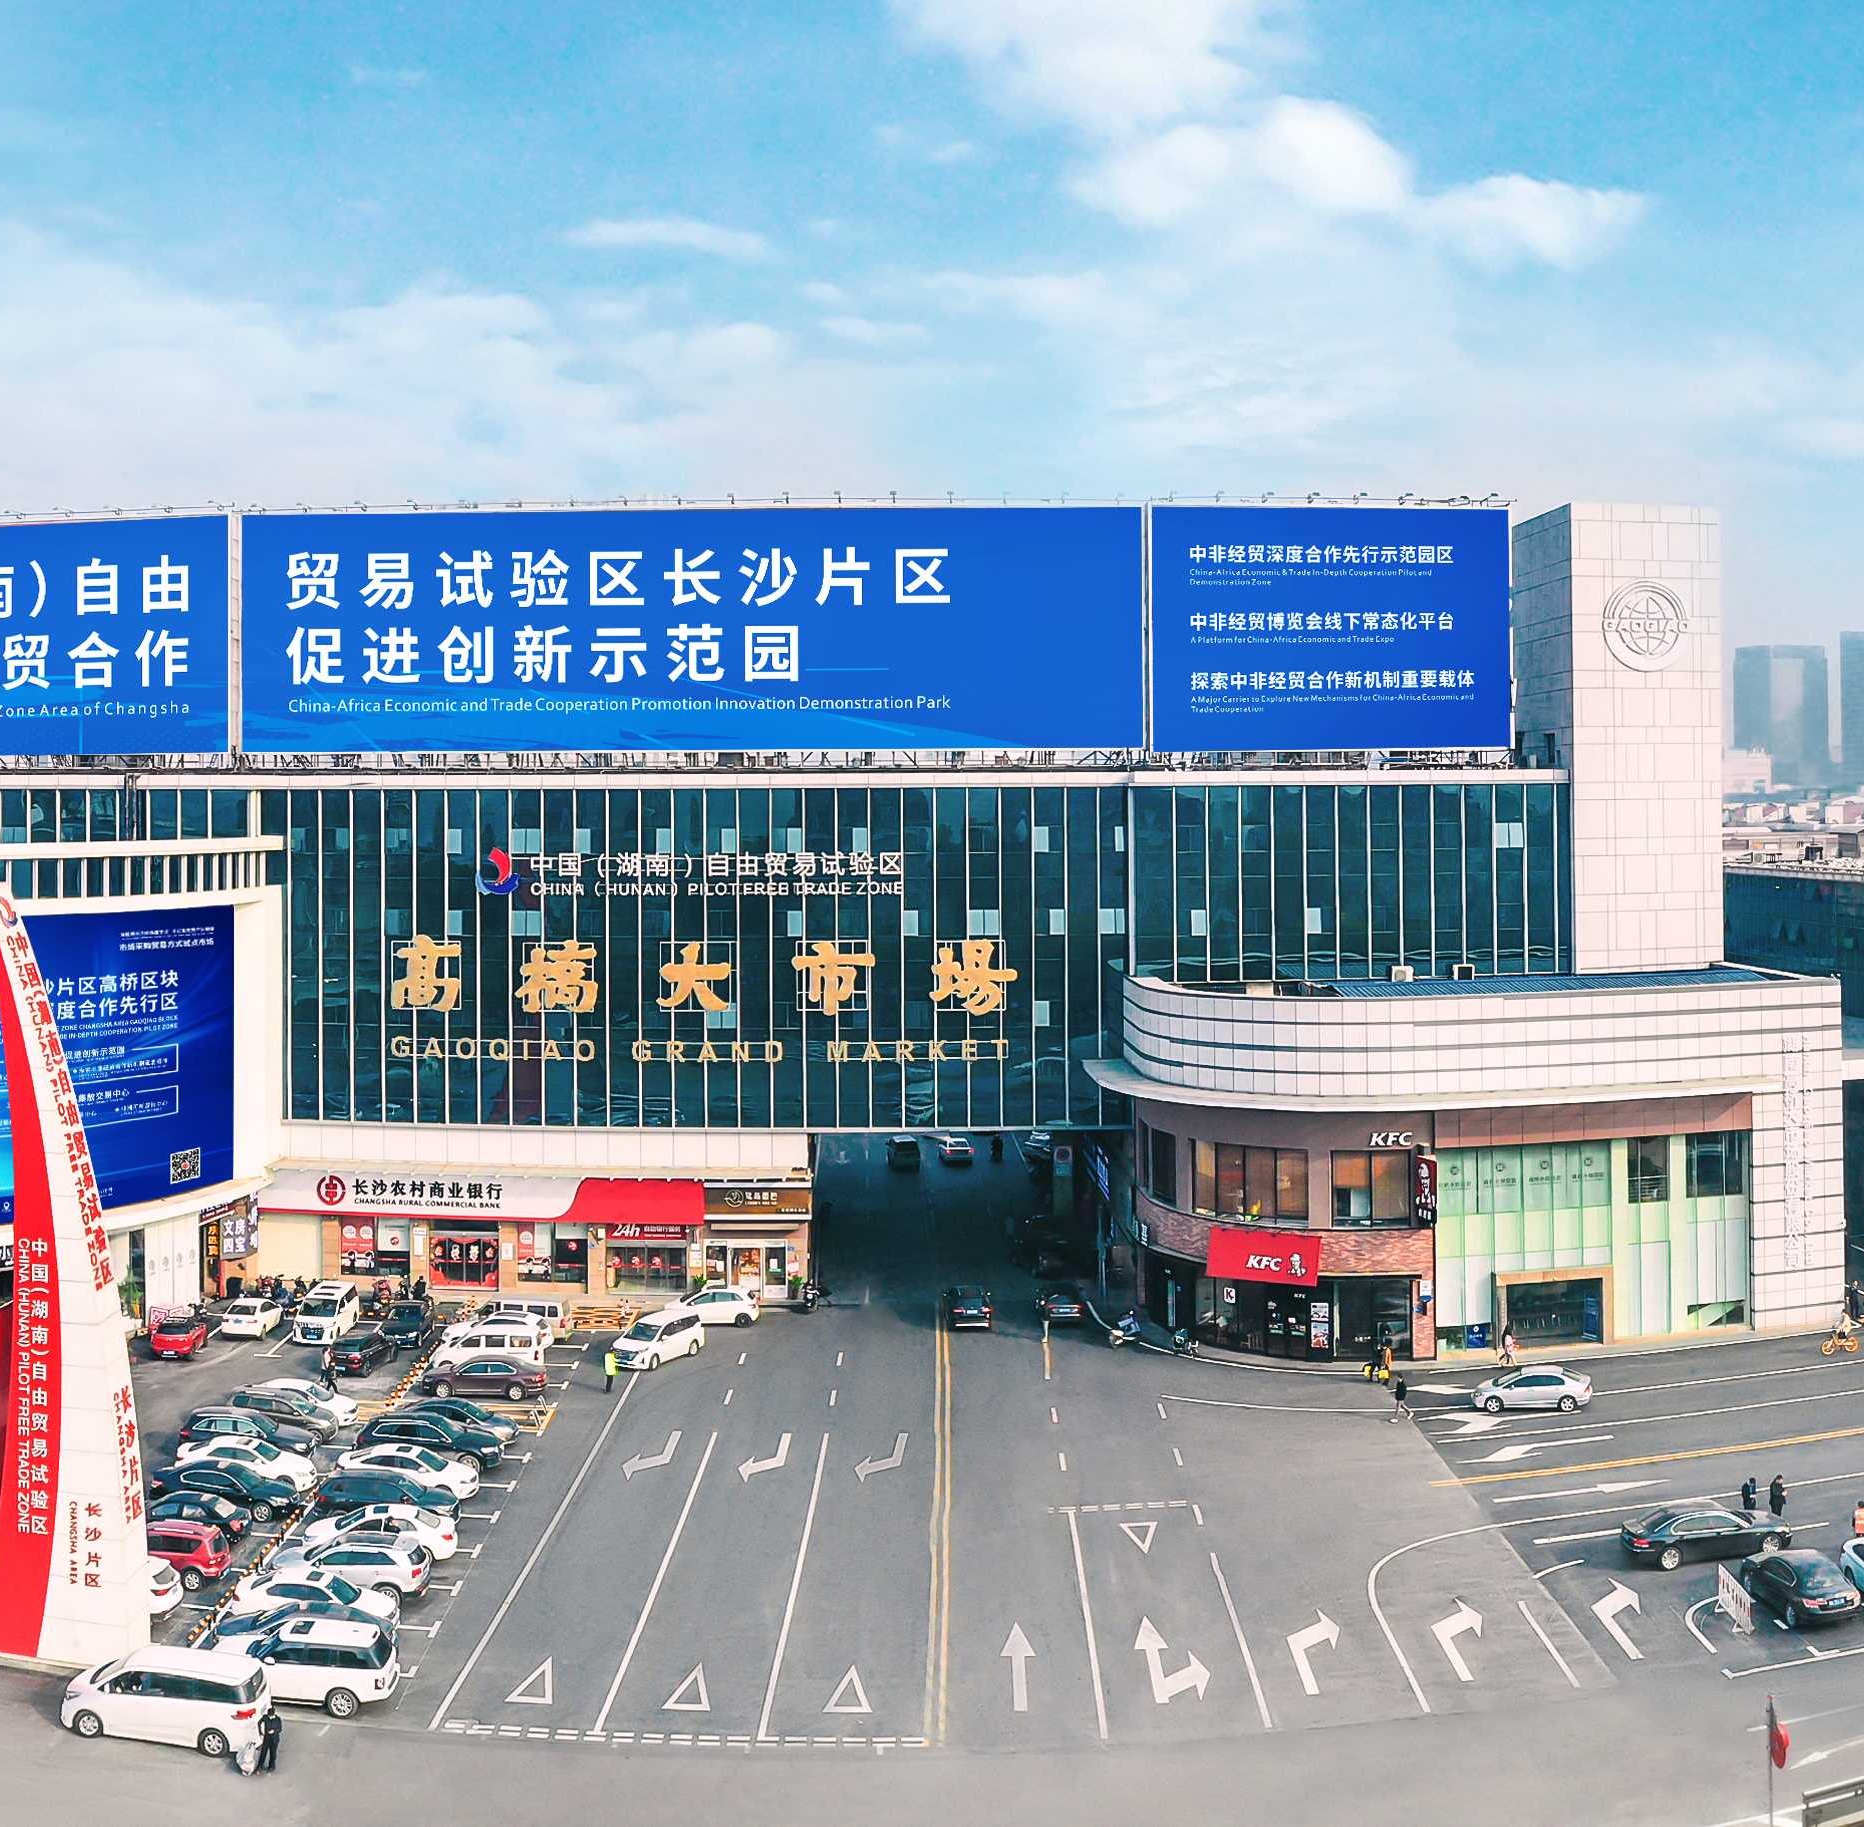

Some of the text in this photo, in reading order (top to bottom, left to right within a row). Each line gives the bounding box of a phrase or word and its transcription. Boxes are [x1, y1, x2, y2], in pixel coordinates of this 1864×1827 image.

[1189, 545, 1454, 564] 中非经贸深度合作先行示范园区
[285, 547, 951, 611] 贸易试验区长沙片区
[1190, 612, 1454, 631] 中非经贸博览会线下常态化平台
[285, 624, 801, 686] 促进创新示范园
[1190, 669, 1475, 690] 探索中非经贸合作新机制重要载体
[39, 703, 79, 717] Area
[83, 702, 101, 717] of
[104, 701, 190, 719] Changsha
[288, 695, 951, 714] China-Africa Economic and Trade Cooperation Promotion Innovation Demonstration Park
[530, 882, 585, 896] CHINA
[688, 882, 735, 896] PILOT
[793, 881, 852, 896] TRADE
[856, 881, 903, 896] ZONE
[390, 1036, 1009, 1063] GAOQIAO GRAND MARKET
[1369, 1131, 1414, 1146] KFC
[352, 1178, 503, 1200] 长沙农村商业银行
[354, 1198, 396, 1206] CHANGSHA
[425, 1199, 478, 1208] COMMERCIAL
[479, 1201, 502, 1209] BANK
[612, 1224, 641, 1238] 24h
[1246, 1254, 1283, 1272] KFC
[17, 1238, 30, 1534] CHINA (HUNAN) PILOT FREE TRADE ZONE
[69, 1501, 78, 1585] CHANGSHA AREA
[84, 1502, 102, 1588] 长沙片区
